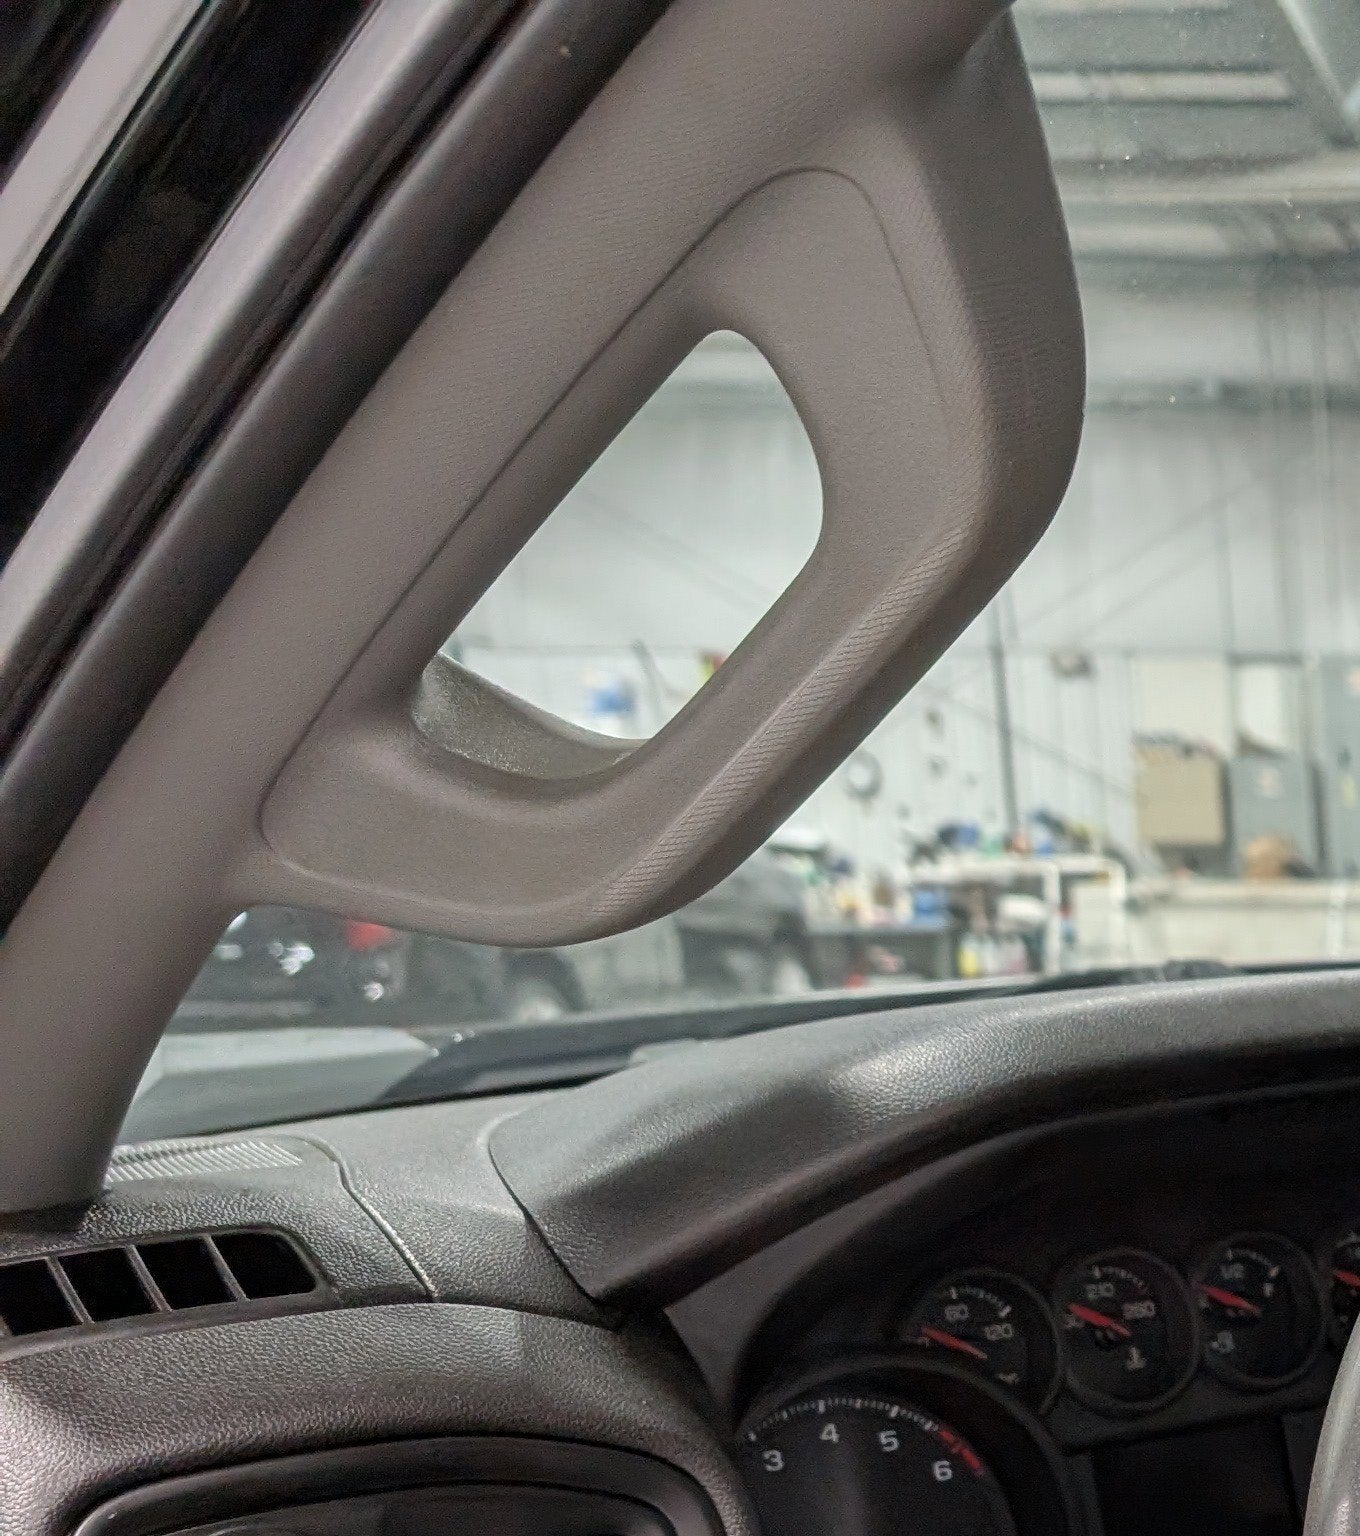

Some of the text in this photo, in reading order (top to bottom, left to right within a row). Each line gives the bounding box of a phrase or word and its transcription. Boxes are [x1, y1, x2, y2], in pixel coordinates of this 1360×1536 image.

[819, 1424, 840, 1443] 4
[879, 1431, 899, 1452] 5
[763, 1449, 785, 1472] 3
[932, 1460, 952, 1481] 6
